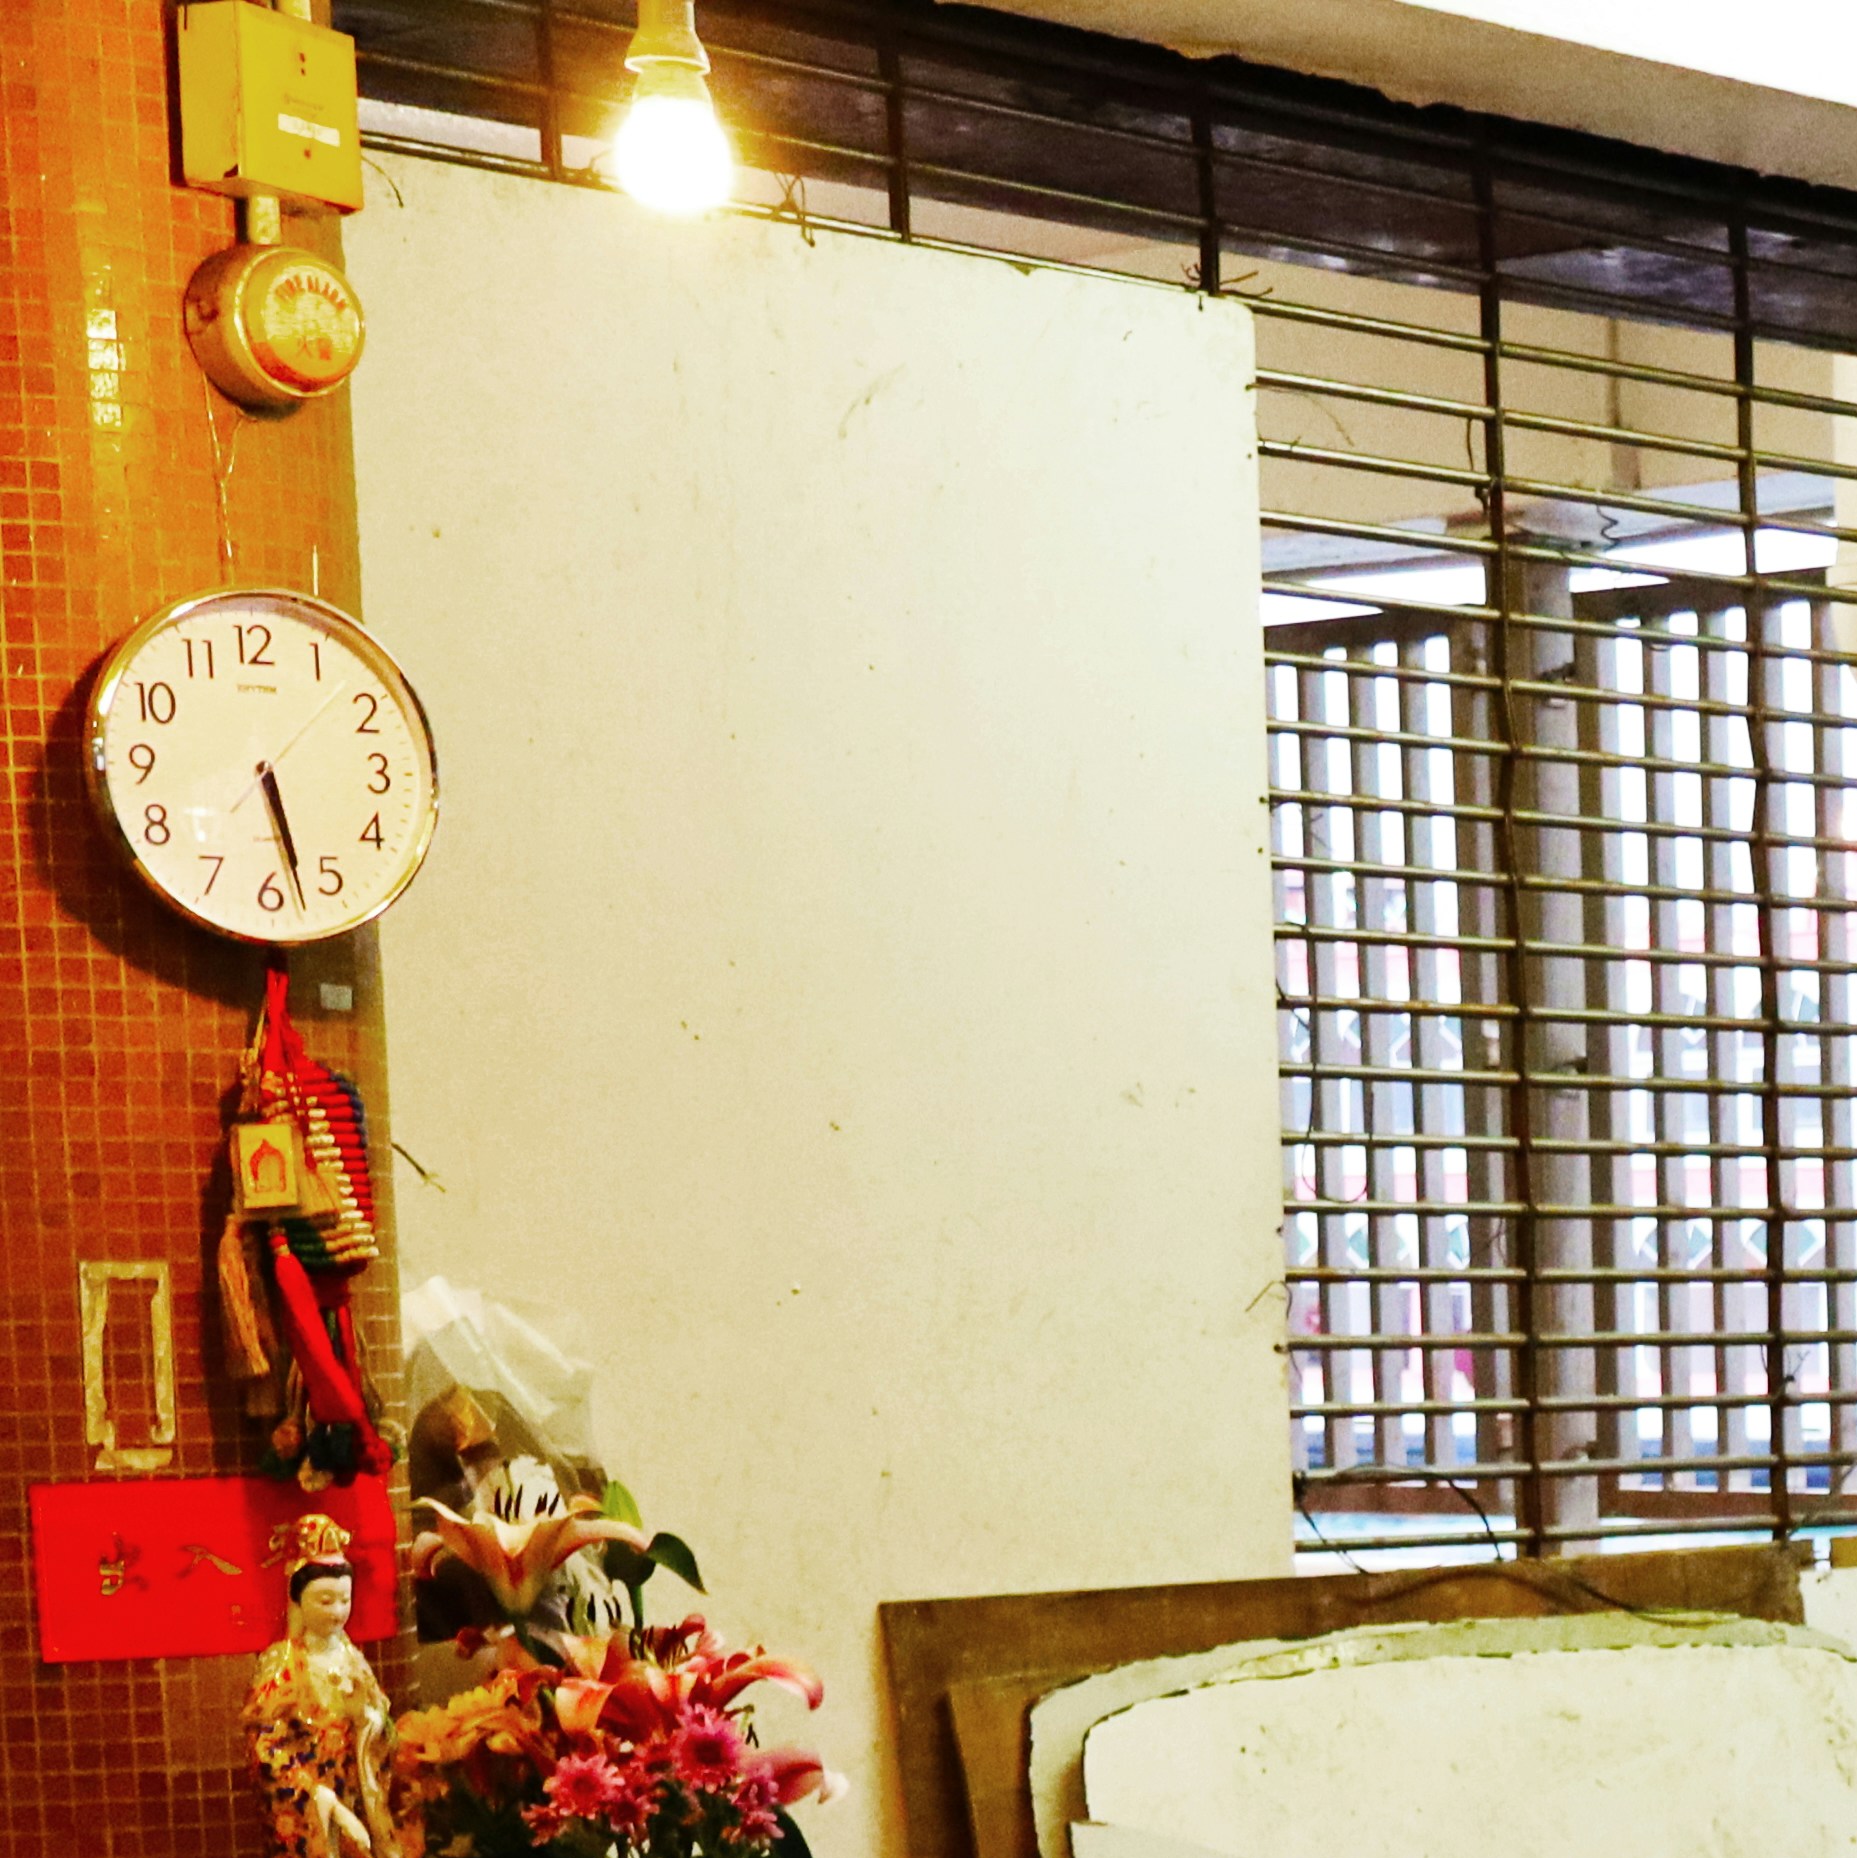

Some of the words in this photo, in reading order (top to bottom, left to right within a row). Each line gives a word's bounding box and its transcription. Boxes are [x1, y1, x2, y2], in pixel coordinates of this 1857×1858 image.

[182, 638, 215, 680] 11
[233, 624, 275, 666] 12
[309, 642, 322, 681] 1
[134, 682, 177, 724] 10
[352, 692, 381, 734] 2
[128, 743, 156, 785] 9
[366, 752, 392, 795] 3
[143, 803, 171, 846] 8
[358, 811, 385, 851] 4
[199, 855, 225, 896] 7
[257, 872, 285, 912] 6
[318, 856, 344, 896] 5
